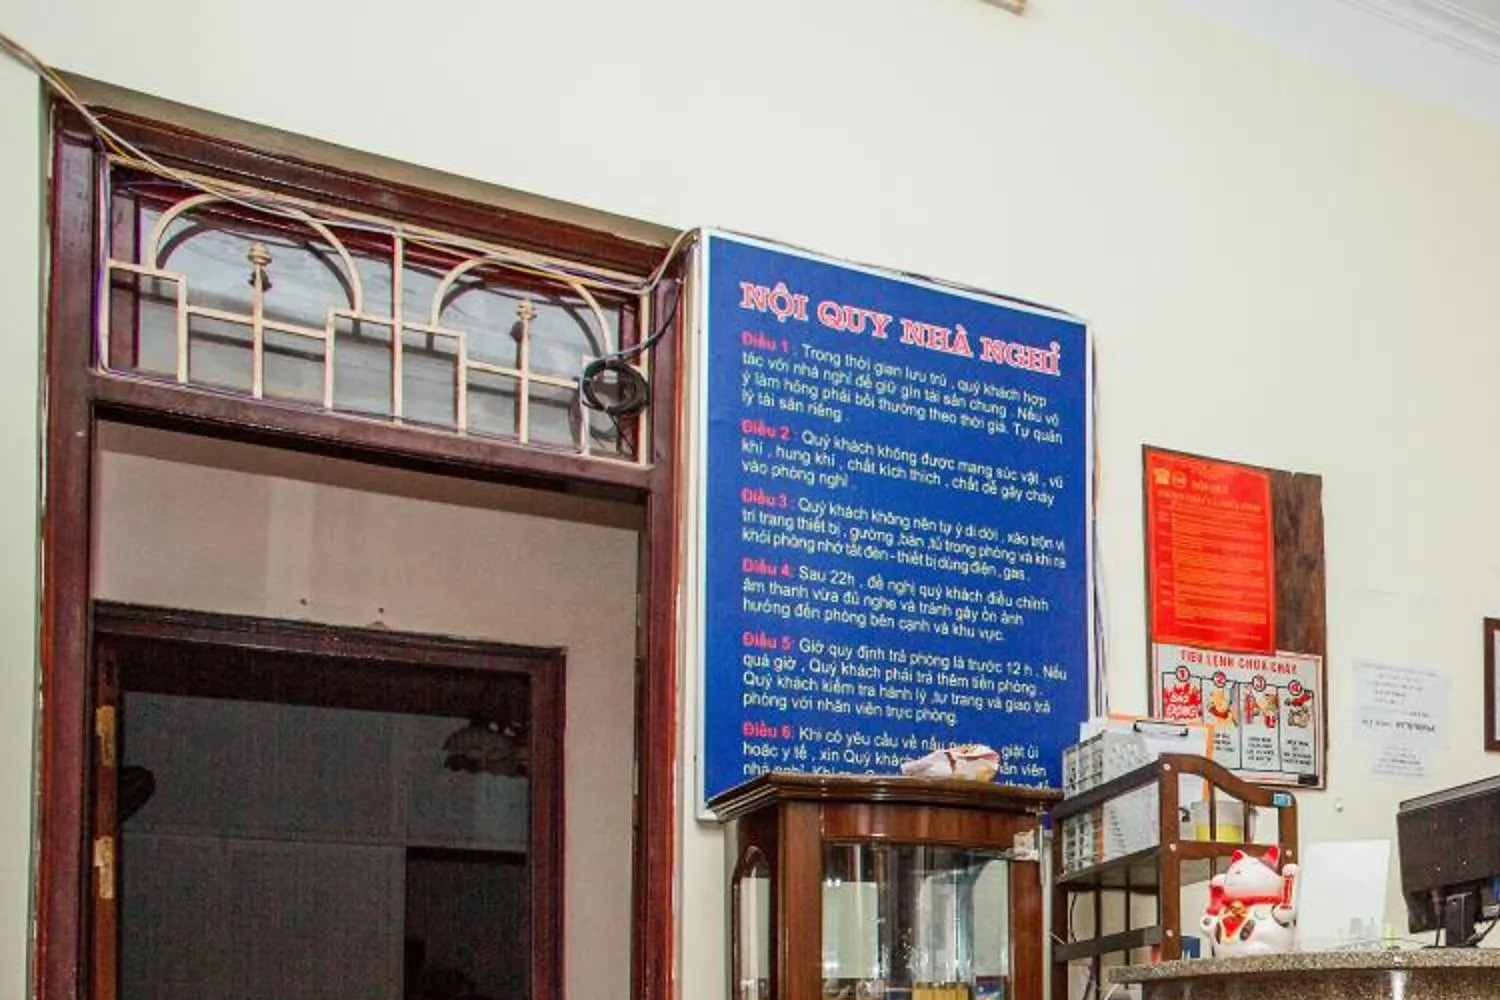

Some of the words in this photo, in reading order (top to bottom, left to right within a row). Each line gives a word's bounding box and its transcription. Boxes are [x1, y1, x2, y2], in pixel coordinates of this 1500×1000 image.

[739, 281, 809, 323] NỘI
[817, 301, 893, 339] QUY
[900, 319, 973, 358] NHÀ
[980, 336, 1061, 376] NGHỈ
[767, 357, 788, 373] với
[793, 362, 818, 379] nhà
[969, 397, 1007, 420] chung
[801, 343, 841, 370] Trong
[844, 352, 870, 371] thời
[983, 381, 1020, 401] khách
[1023, 390, 1046, 411] hợp
[929, 406, 956, 424] theo
[776, 444, 811, 468] hung
[801, 430, 830, 453] Quý
[834, 436, 874, 456] khách
[877, 443, 916, 468] không
[921, 451, 955, 472] được
[771, 464, 814, 487] phòng
[798, 497, 827, 520] Quý
[829, 502, 868, 521] khách
[871, 508, 909, 532] không
[979, 544, 1016, 565] phòng
[769, 580, 808, 599] thanh
[863, 594, 896, 612] nghe
[799, 565, 826, 583] Sau
[830, 570, 854, 586] 22h
[919, 583, 942, 602] quý
[945, 585, 982, 603] khách
[824, 607, 866, 629] phòng
[952, 621, 974, 637] khu
[799, 638, 824, 655] Giờ
[827, 645, 852, 662] quy
[857, 645, 885, 662] định
[910, 651, 949, 672] phòng
[967, 656, 1002, 673] trước
[1006, 661, 1020, 675] 12
[743, 671, 772, 692] Quý
[777, 674, 818, 692] khách
[951, 691, 983, 711] trang
[809, 658, 837, 679] Quý
[841, 661, 880, 678] khách
[937, 671, 968, 687] thêm
[997, 678, 1036, 698] phòng
[743, 691, 786, 713] phòng
[791, 695, 812, 710] với
[817, 697, 850, 713] nhân
[855, 701, 882, 716] viên
[799, 727, 821, 742] Khi
[825, 729, 842, 744] có
[845, 731, 870, 749] yêu
[743, 741, 777, 761] hoặc
[781, 748, 790, 764] y
[820, 748, 839, 762] xin
[843, 749, 870, 769] Quý
